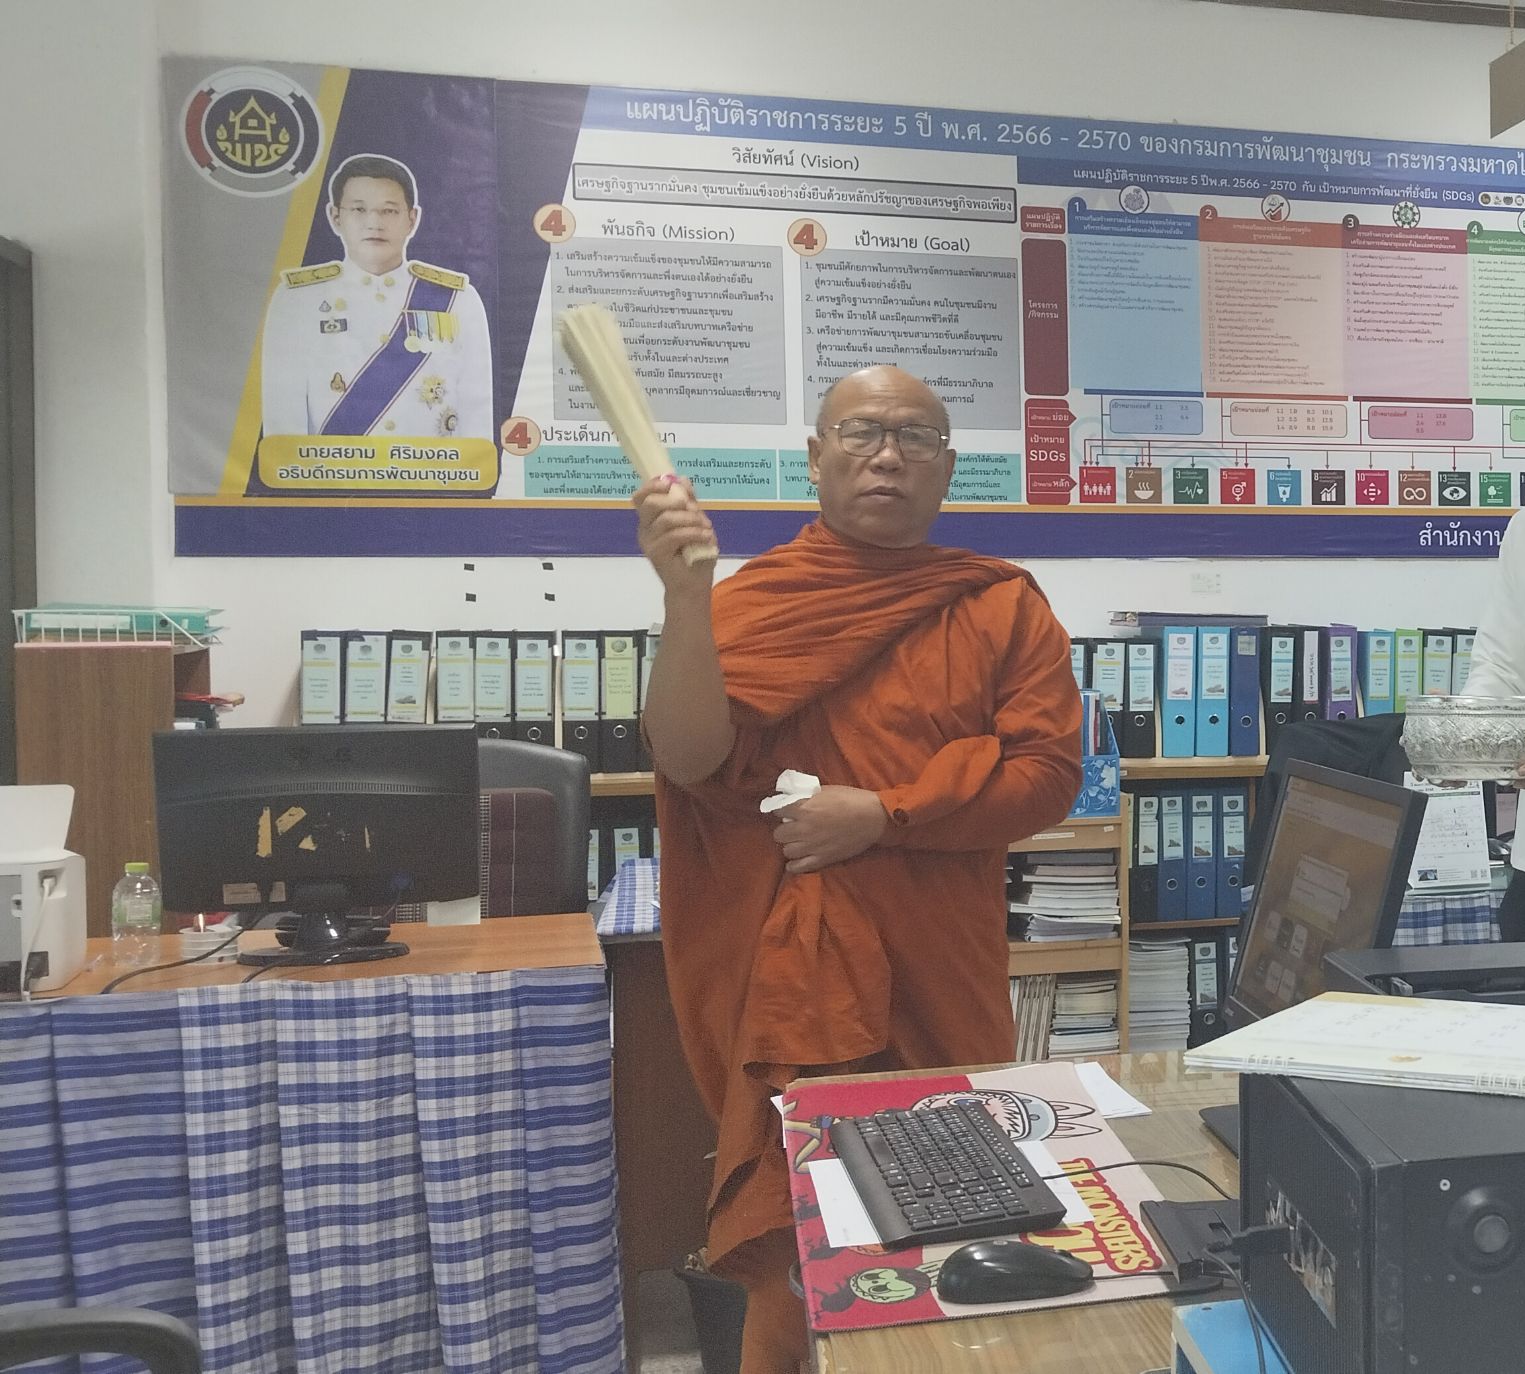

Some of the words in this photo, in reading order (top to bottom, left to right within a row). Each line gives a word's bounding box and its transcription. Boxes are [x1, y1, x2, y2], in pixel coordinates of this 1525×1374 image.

[625, 97, 884, 135] แผนปฏิบัติราชการระยะ
[894, 115, 908, 137] 5
[916, 111, 934, 138] ปี
[941, 119, 988, 144] พ.ศ.
[997, 123, 1052, 146] 2566
[1078, 129, 1132, 150] 2570
[1139, 134, 1372, 172] ของกรมการพัฒนาชุมชน
[732, 147, 795, 168] วิสัยทัศน์
[800, 152, 860, 172] (Vision)
[576, 173, 699, 197] เศรษฐกิจฐานรากมั่นคง
[1073, 167, 1190, 185] แผนปฏิบัติราชการระยะ
[1190, 175, 1199, 186] 5
[1233, 177, 1260, 190] 2566
[1270, 179, 1297, 192] 2570
[1302, 179, 1316, 194] กับ
[1441, 189, 1475, 204] (SDGs)
[1073, 201, 1080, 212] 1
[1205, 209, 1213, 220] 2
[540, 208, 567, 237] 4
[1347, 217, 1355, 229] 3
[601, 220, 656, 239] พันธกิจ
[662, 223, 735, 242] (Mission)
[1470, 224, 1478, 235] 4
[793, 223, 818, 250] 4
[855, 229, 918, 249] เป้าหมาย
[924, 236, 971, 253] (Goal)
[505, 422, 531, 450] 4
[299, 446, 375, 459] นายสยาม
[389, 444, 460, 461] ศิริมงคล
[1029, 449, 1066, 462] SDGs
[278, 466, 480, 485] อธิบดีกรมการพัฒนาชุมชน
[1082, 469, 1087, 478] 1
[1128, 469, 1135, 479] 2
[1175, 470, 1182, 479] 3
[1222, 471, 1229, 480] 5
[1269, 472, 1275, 481] 6
[1313, 472, 1320, 481] 8
[1356, 473, 1366, 482] 10
[1400, 473, 1408, 482] 12
[1439, 473, 1448, 483] 13
[1480, 474, 1489, 483] 15
